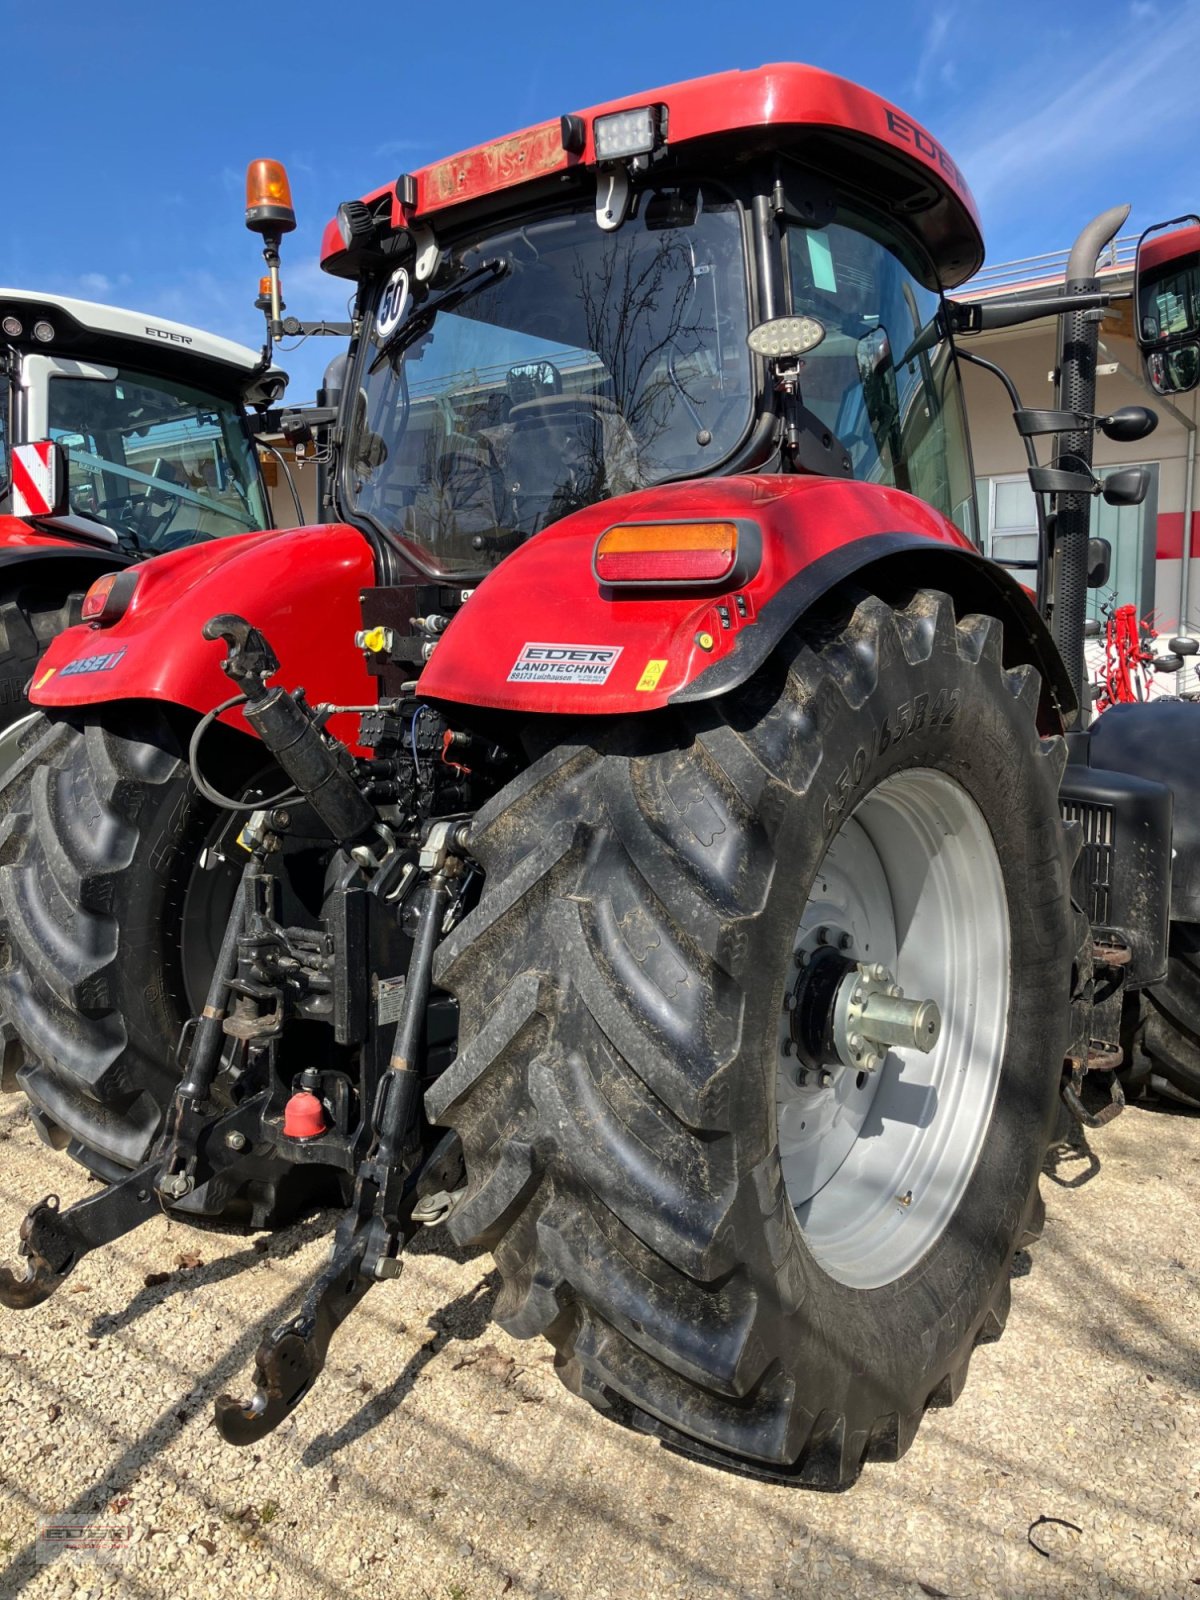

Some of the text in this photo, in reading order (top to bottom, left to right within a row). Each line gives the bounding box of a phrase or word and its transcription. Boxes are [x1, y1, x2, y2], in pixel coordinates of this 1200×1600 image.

[883, 107, 969, 197] EDER
[381, 279, 405, 327] 50
[145, 327, 193, 345] EDER
[525, 648, 614, 662] EDER
[510, 672, 533, 680] 89173
[514, 662, 610, 675] LANDTECHNIK
